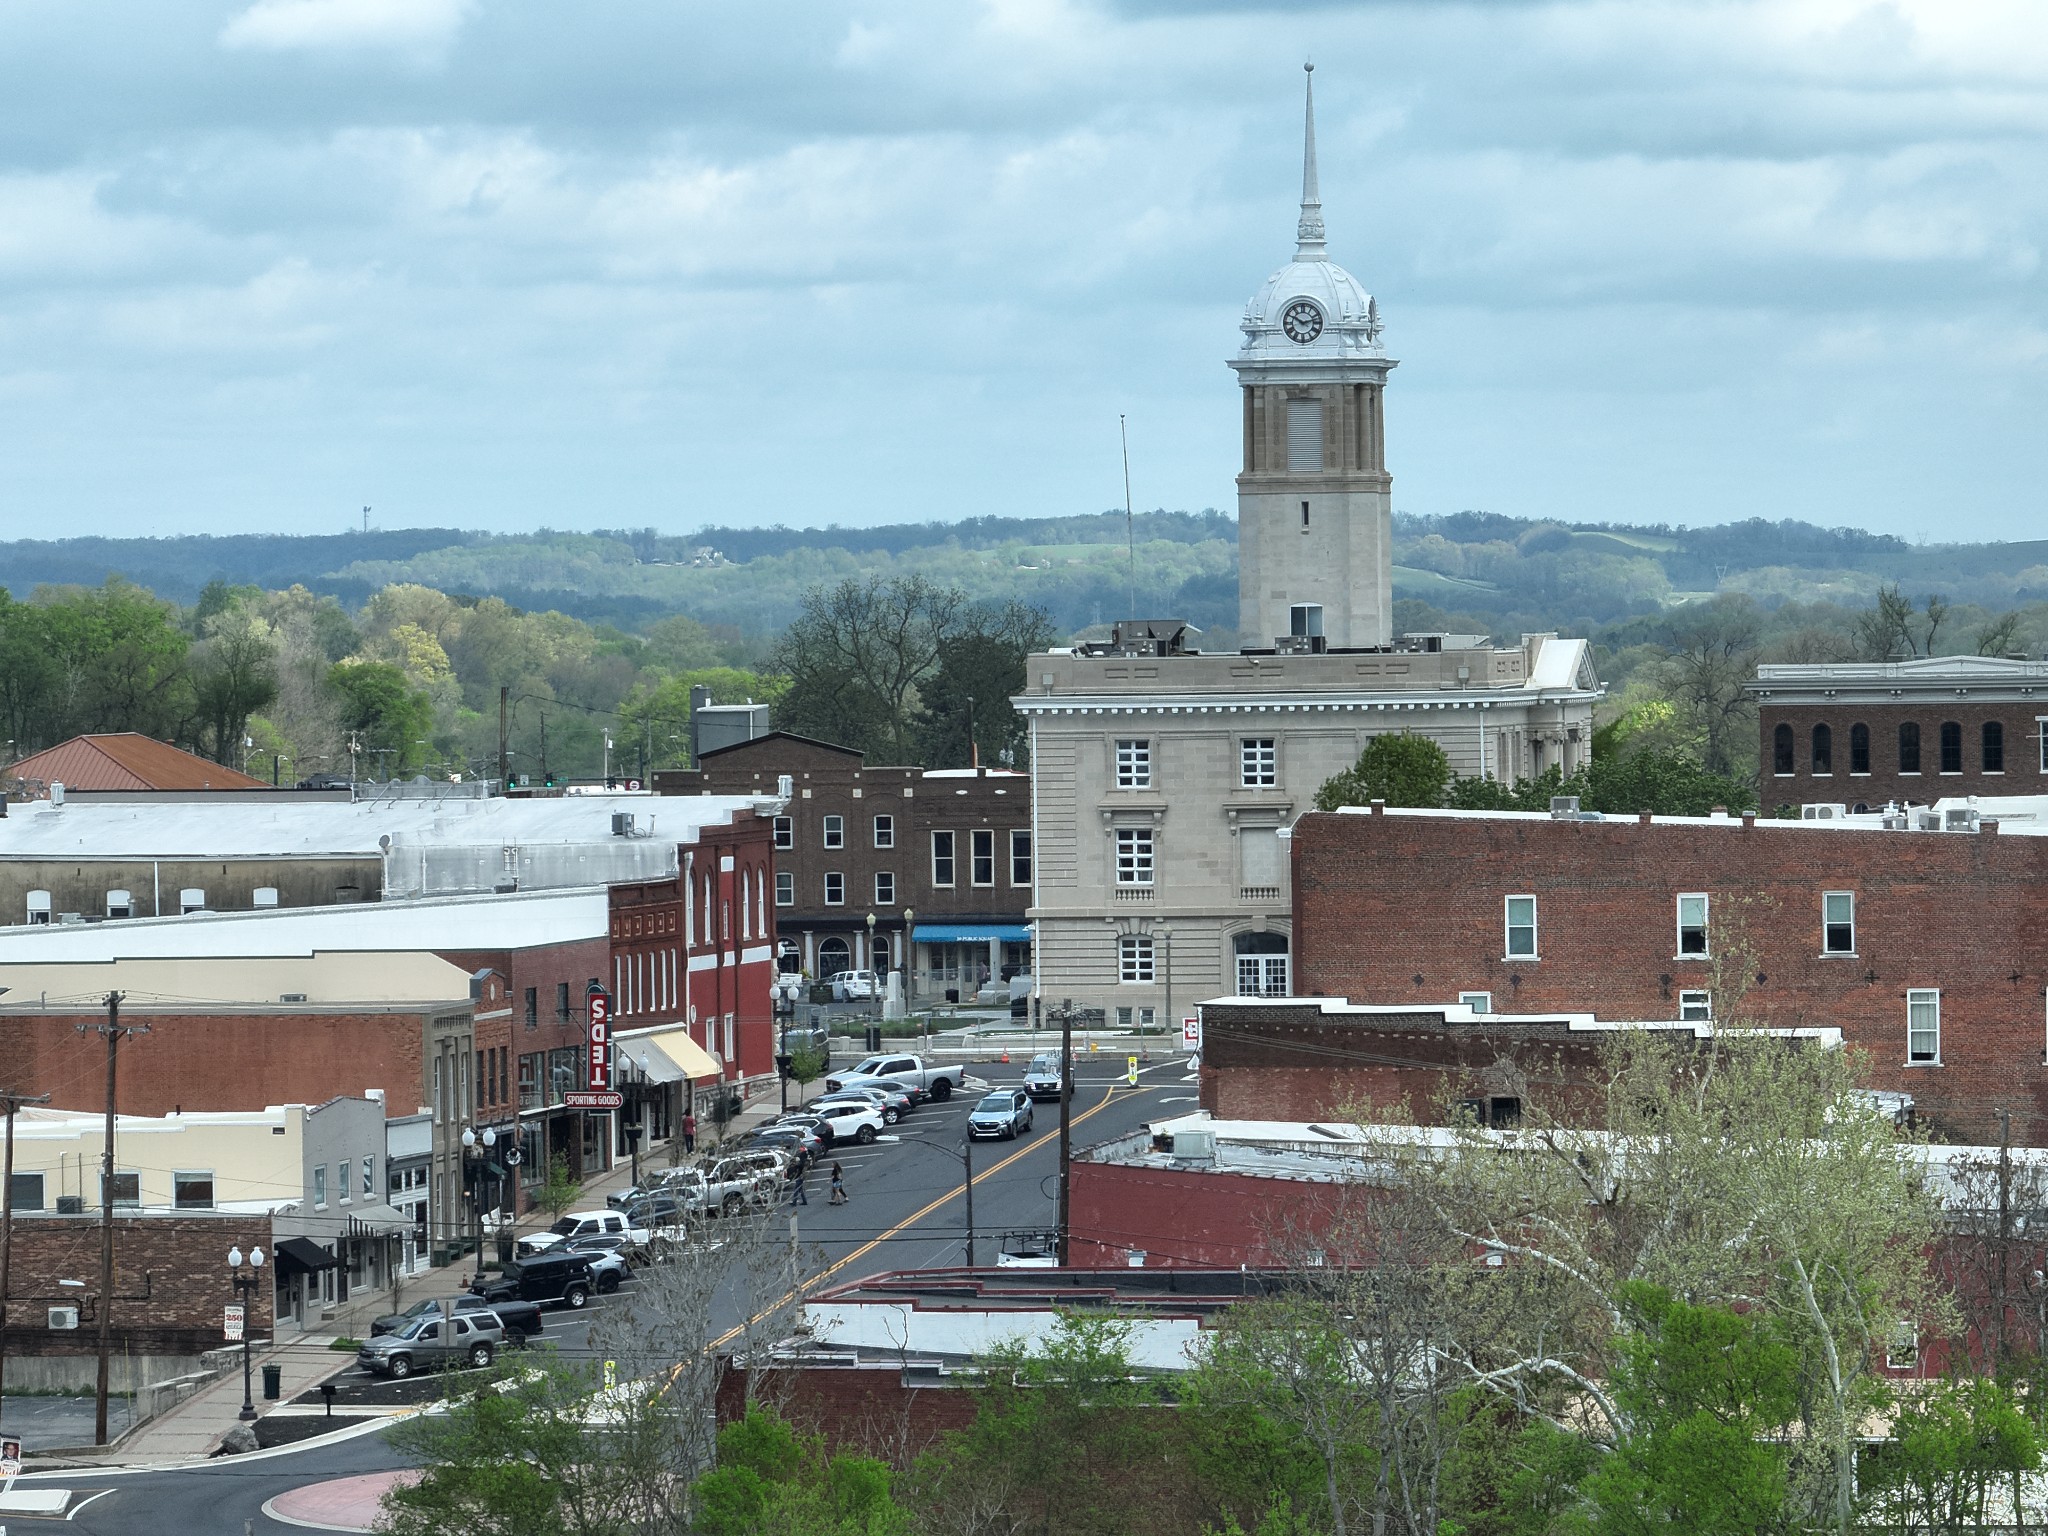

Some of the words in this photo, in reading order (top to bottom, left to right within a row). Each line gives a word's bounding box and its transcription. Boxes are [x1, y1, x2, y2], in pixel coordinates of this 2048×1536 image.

[566, 1095, 597, 1105] SPORTING
[598, 1095, 620, 1105] GOODS
[226, 1314, 243, 1322] 250
